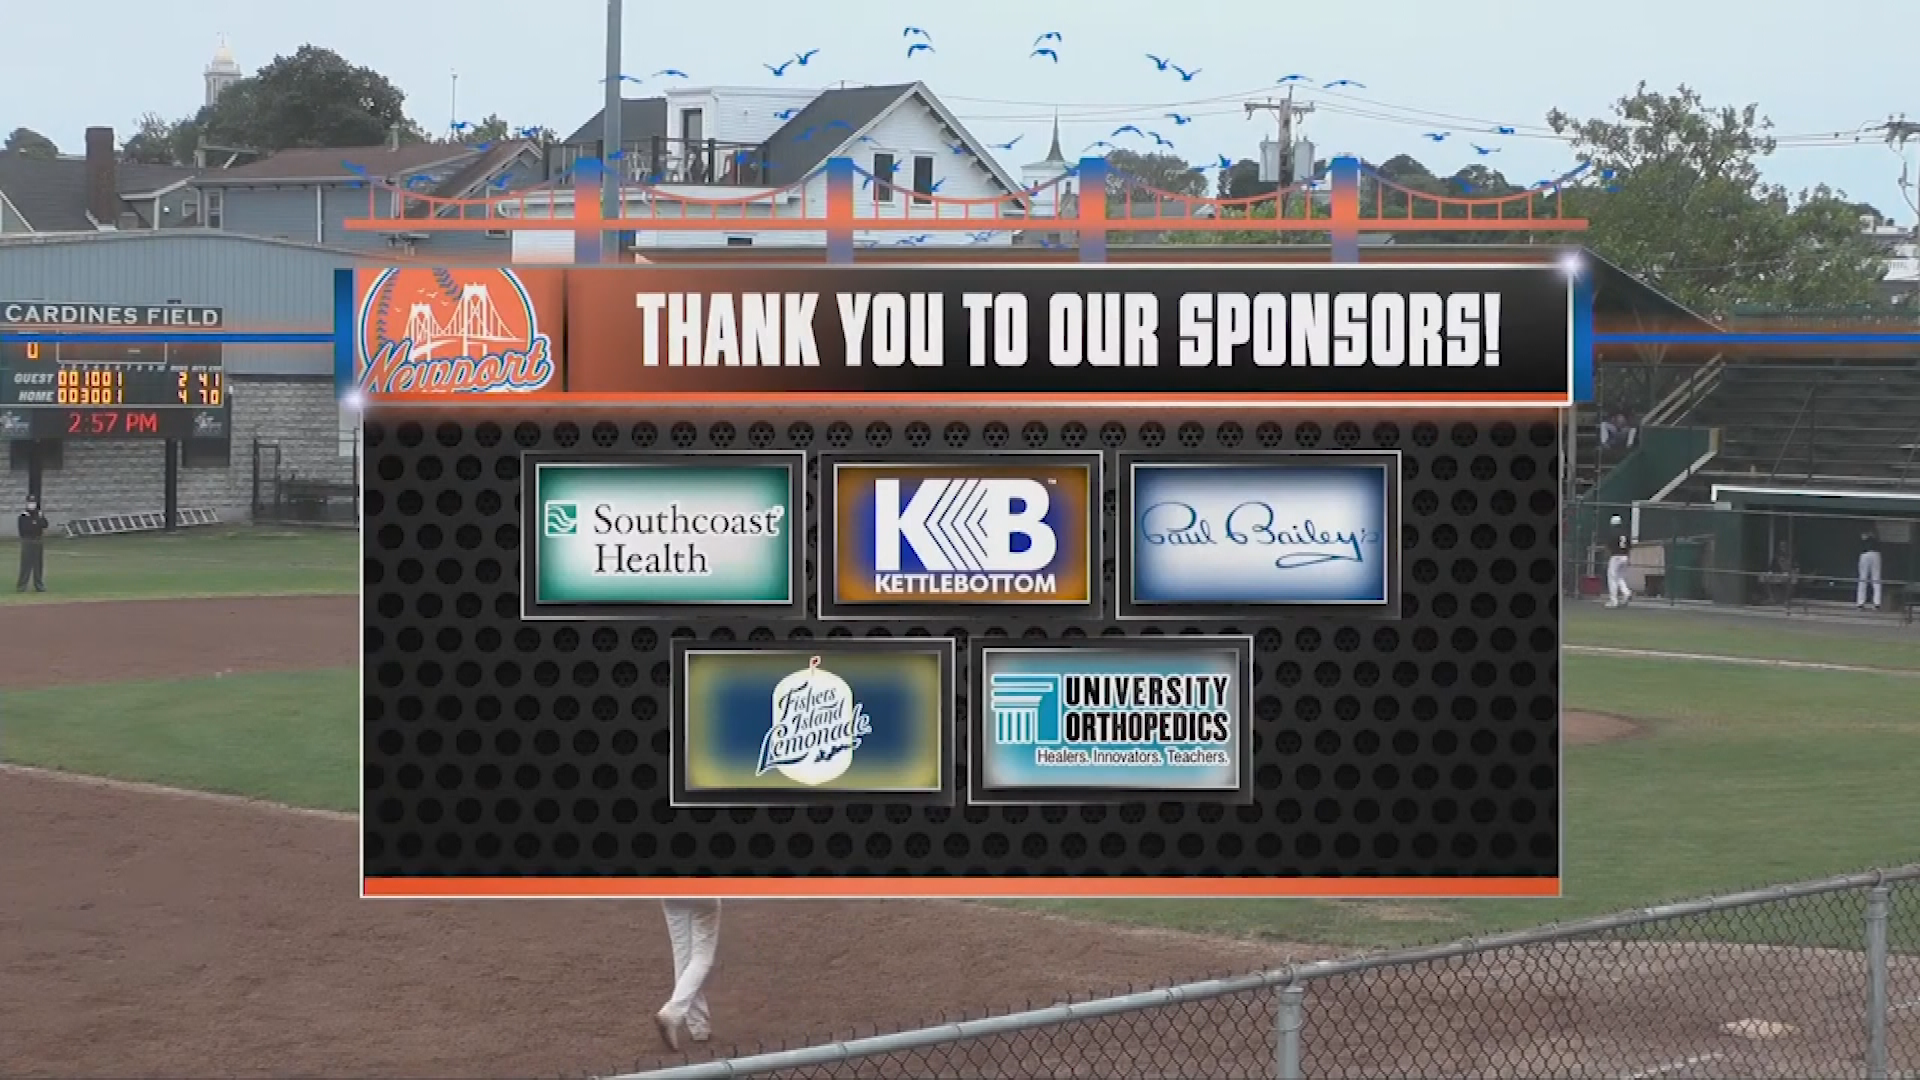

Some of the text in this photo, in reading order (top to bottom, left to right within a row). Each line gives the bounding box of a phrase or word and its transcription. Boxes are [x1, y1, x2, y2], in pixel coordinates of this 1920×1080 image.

[5, 304, 219, 326] CARDINES FIELD
[14, 372, 55, 384] GUEST
[19, 390, 55, 402] HOME
[67, 411, 158, 433] 2:57 PM
